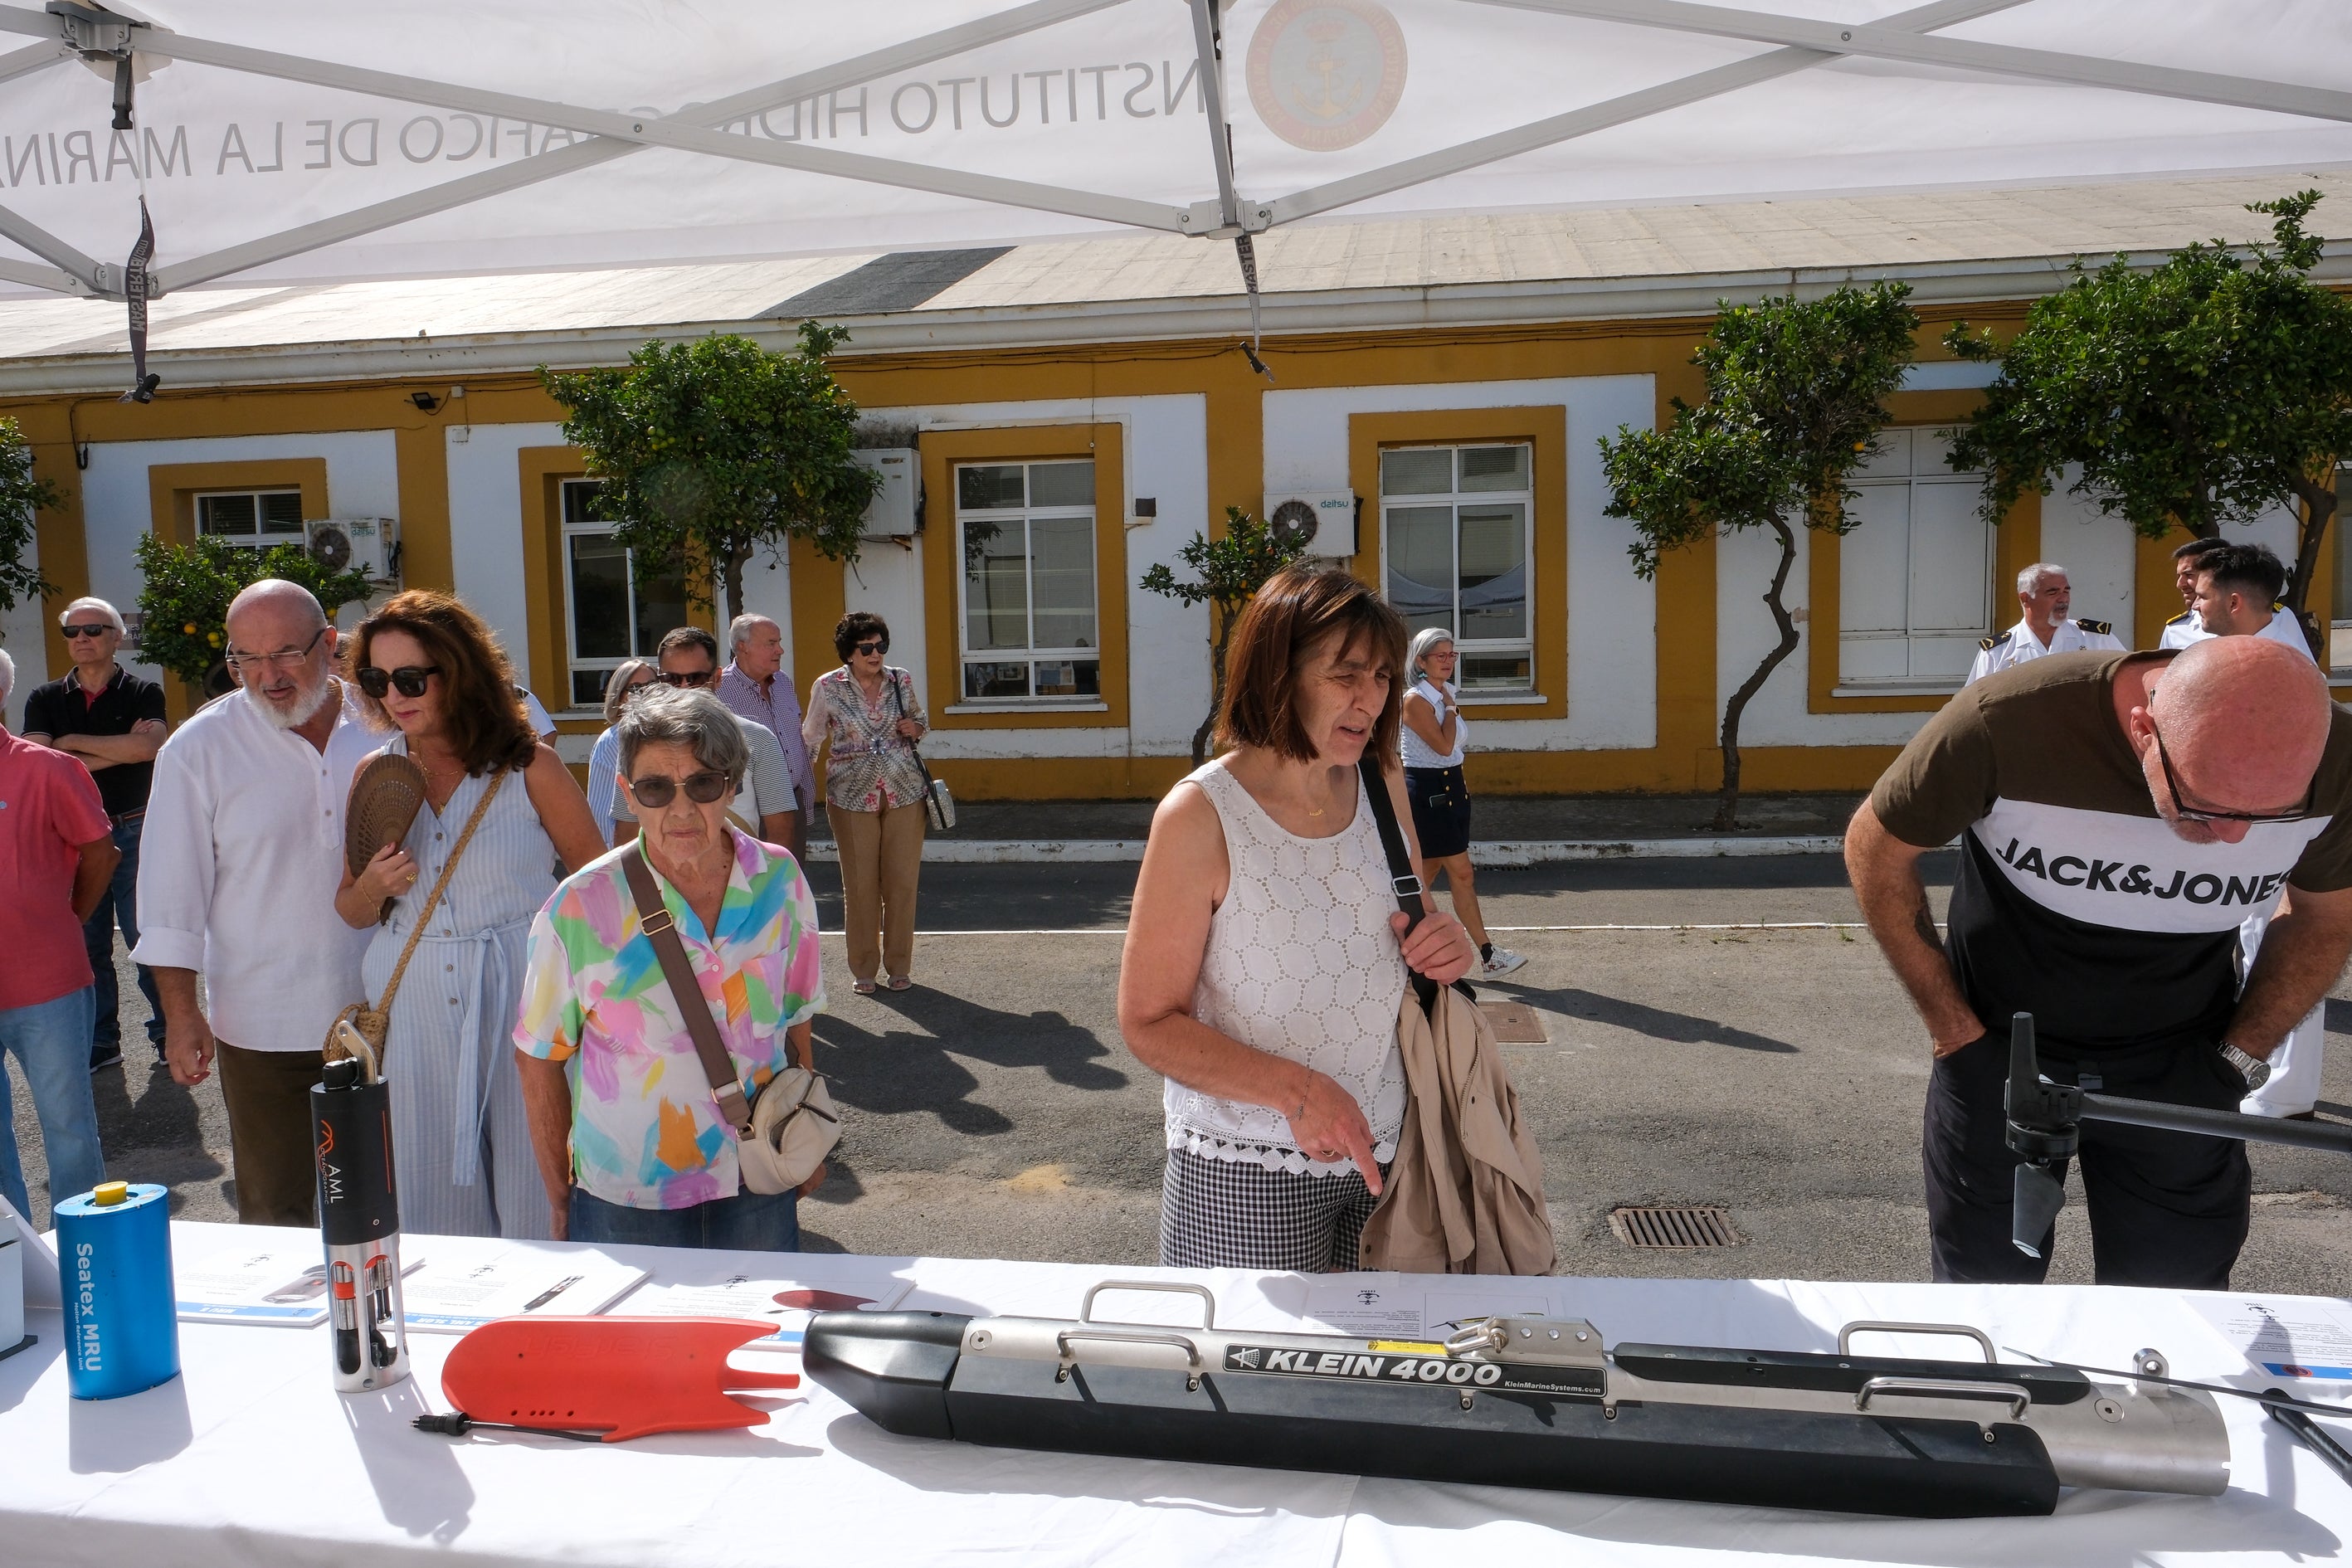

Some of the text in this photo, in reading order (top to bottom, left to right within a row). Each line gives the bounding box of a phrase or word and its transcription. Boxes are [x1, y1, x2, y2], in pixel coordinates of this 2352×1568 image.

[328, 1164, 344, 1204] AML
[76, 1243, 102, 1371] Seatex MRU
[1265, 1350, 1601, 1394] KLEIN 4000 KleinMarineSystems.com
